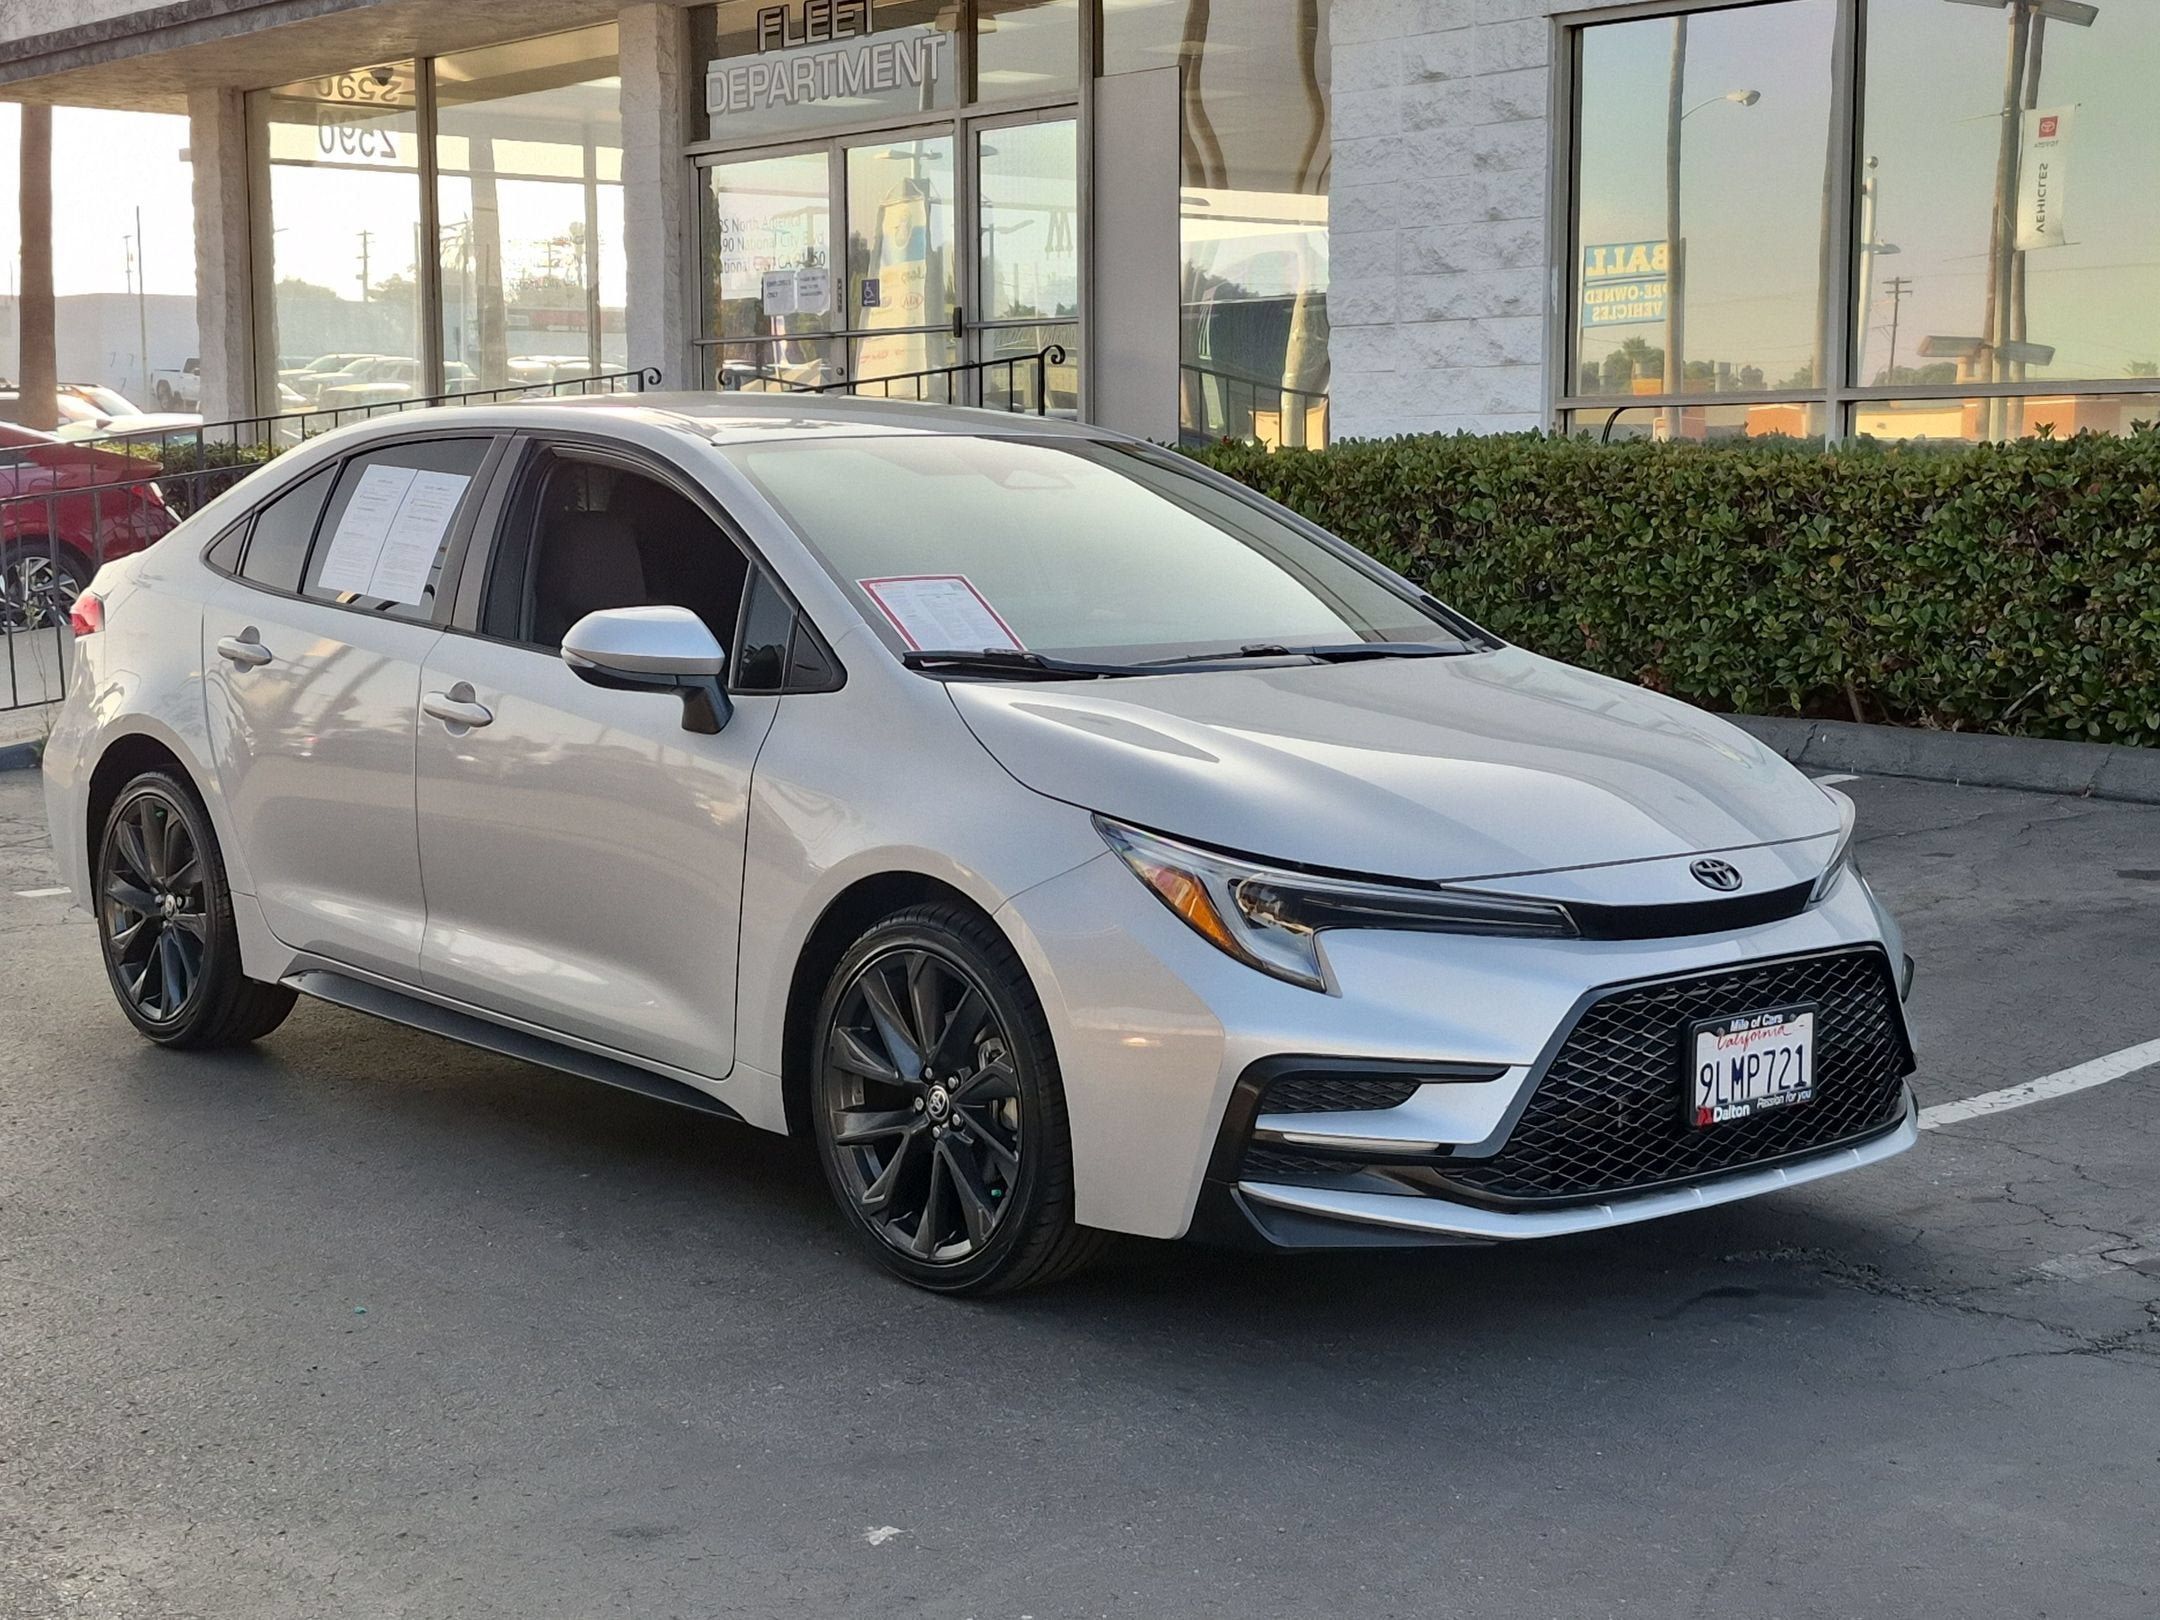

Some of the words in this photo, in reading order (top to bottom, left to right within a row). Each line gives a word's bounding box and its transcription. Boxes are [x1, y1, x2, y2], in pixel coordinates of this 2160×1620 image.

[705, 34, 947, 116] DEPARTMENT
[1716, 1025, 1792, 1052] California
[1699, 1043, 1808, 1106] 9LMP721
[1712, 1104, 1751, 1123] Dalton
